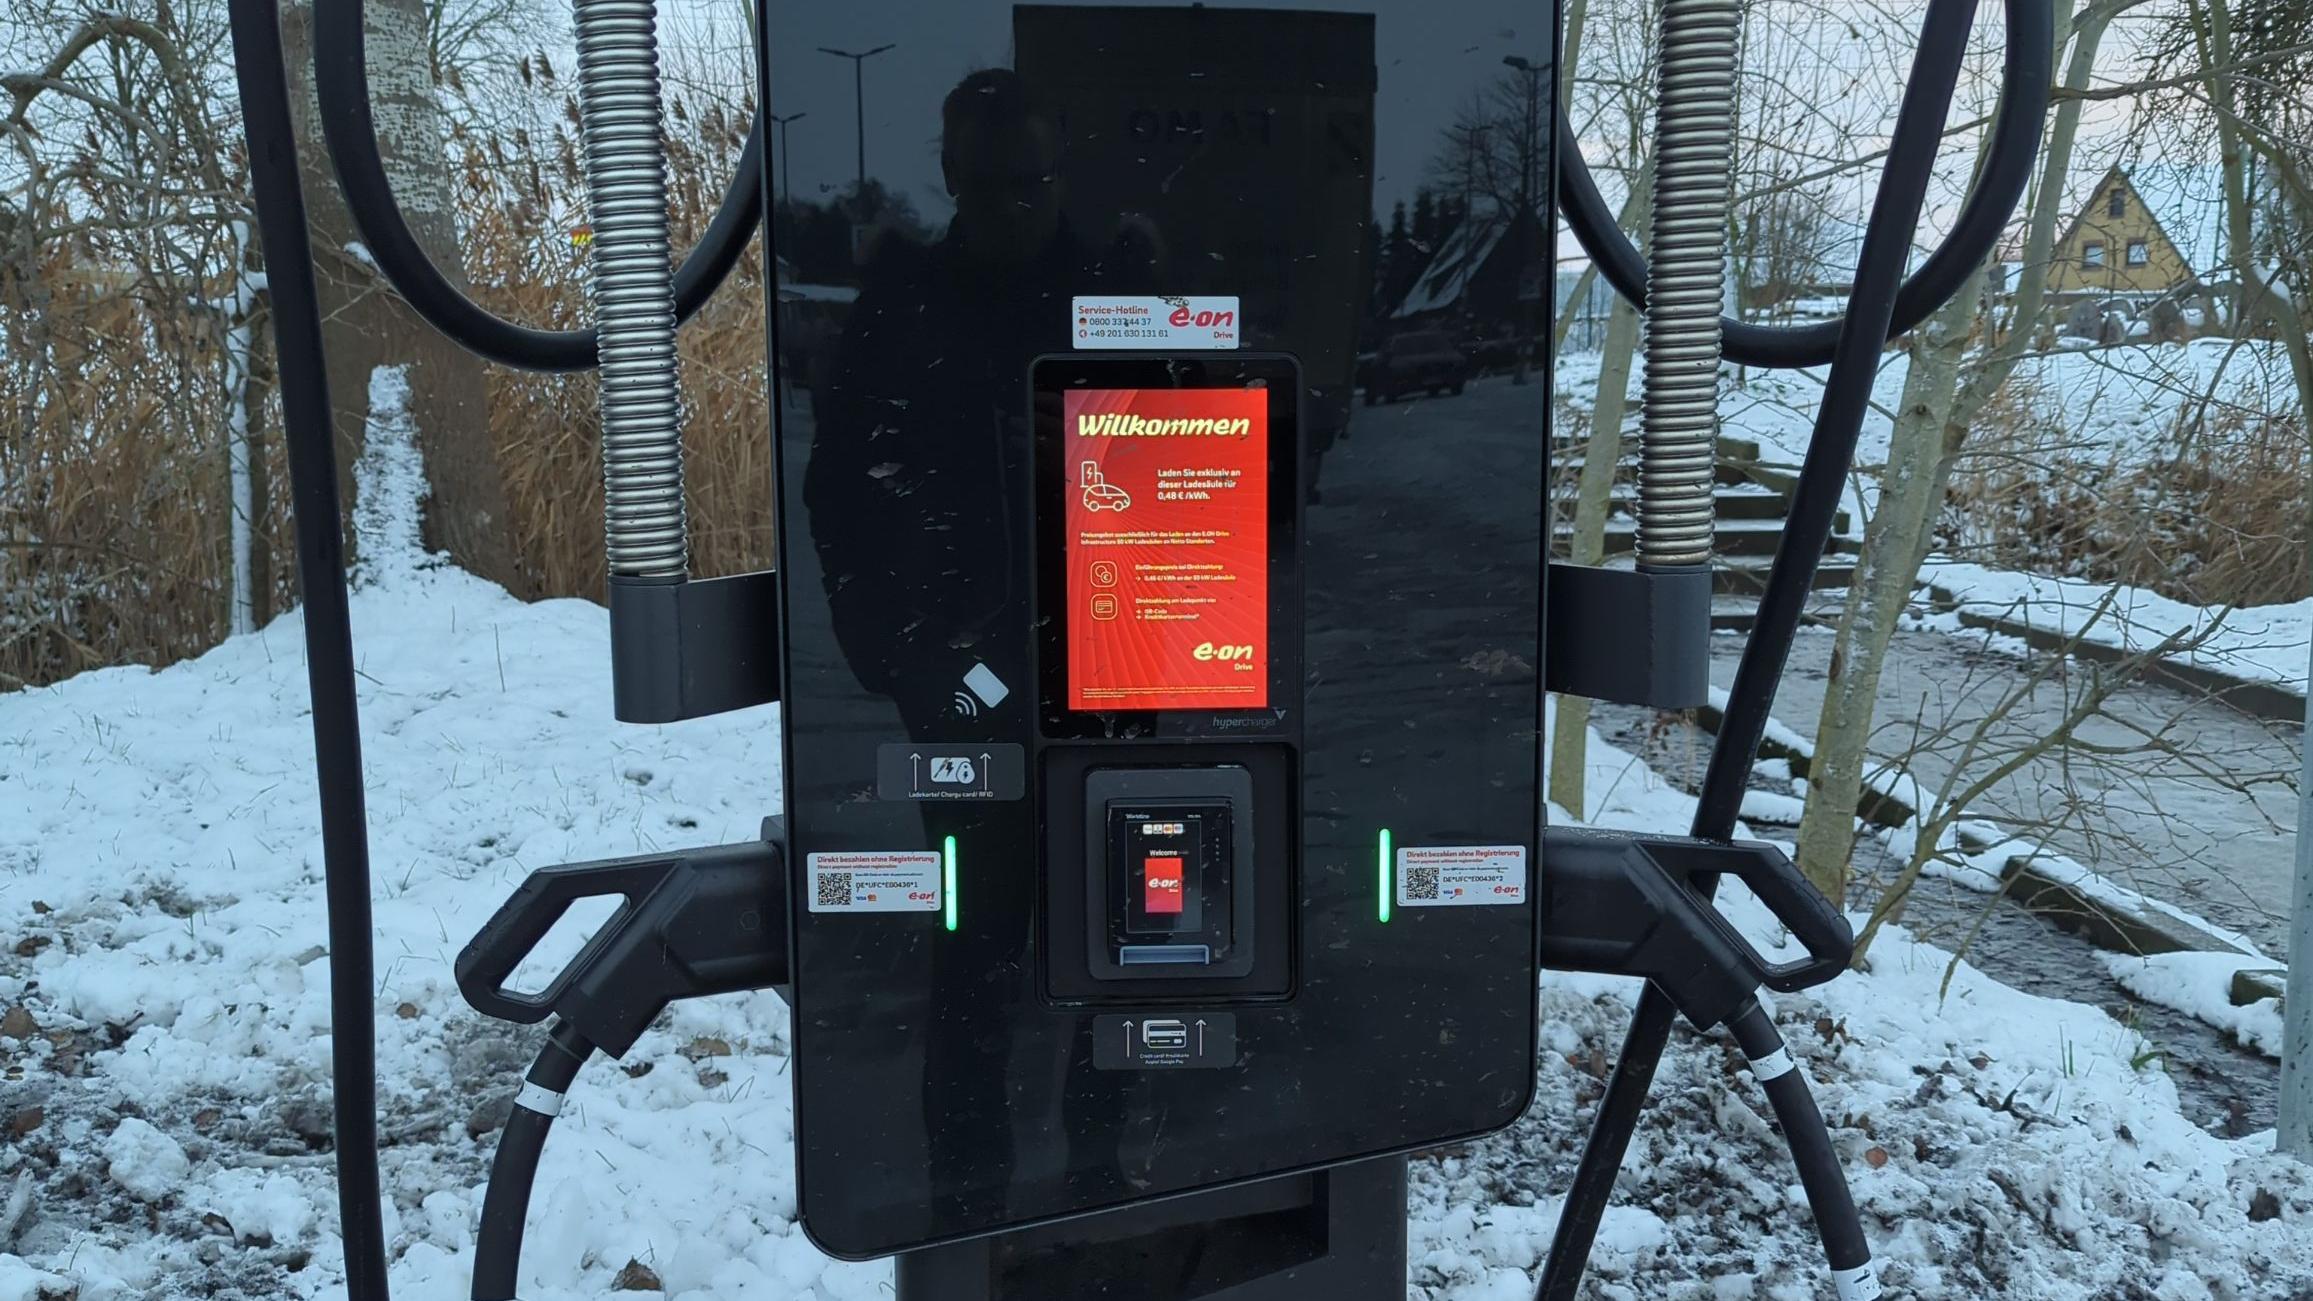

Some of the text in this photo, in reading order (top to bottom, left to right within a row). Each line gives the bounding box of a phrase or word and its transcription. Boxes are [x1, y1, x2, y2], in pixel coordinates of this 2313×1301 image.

[1078, 306, 1148, 315] Service-Hotline
[1089, 317, 1110, 326] 0800
[1141, 317, 1151, 326] 37
[1090, 329, 1105, 338] +49
[1107, 329, 1122, 338] 201
[1142, 329, 1156, 338] 131
[1213, 331, 1234, 339] Drive
[1078, 413, 1250, 436] Willkommen
[1157, 469, 1181, 477] Laden
[1183, 469, 1195, 477] Sie
[1197, 468, 1229, 477] exklusiv
[1157, 480, 1182, 488] dieser
[1183, 480, 1222, 488] Ladesäule
[1157, 491, 1177, 501] 0,48
[1178, 491, 1184, 500] €
[1234, 663, 1253, 671] Drive
[1476, 849, 1520, 858] Registrierung
[840, 855, 869, 863] bezahlen
[889, 855, 935, 864] Registrierung
